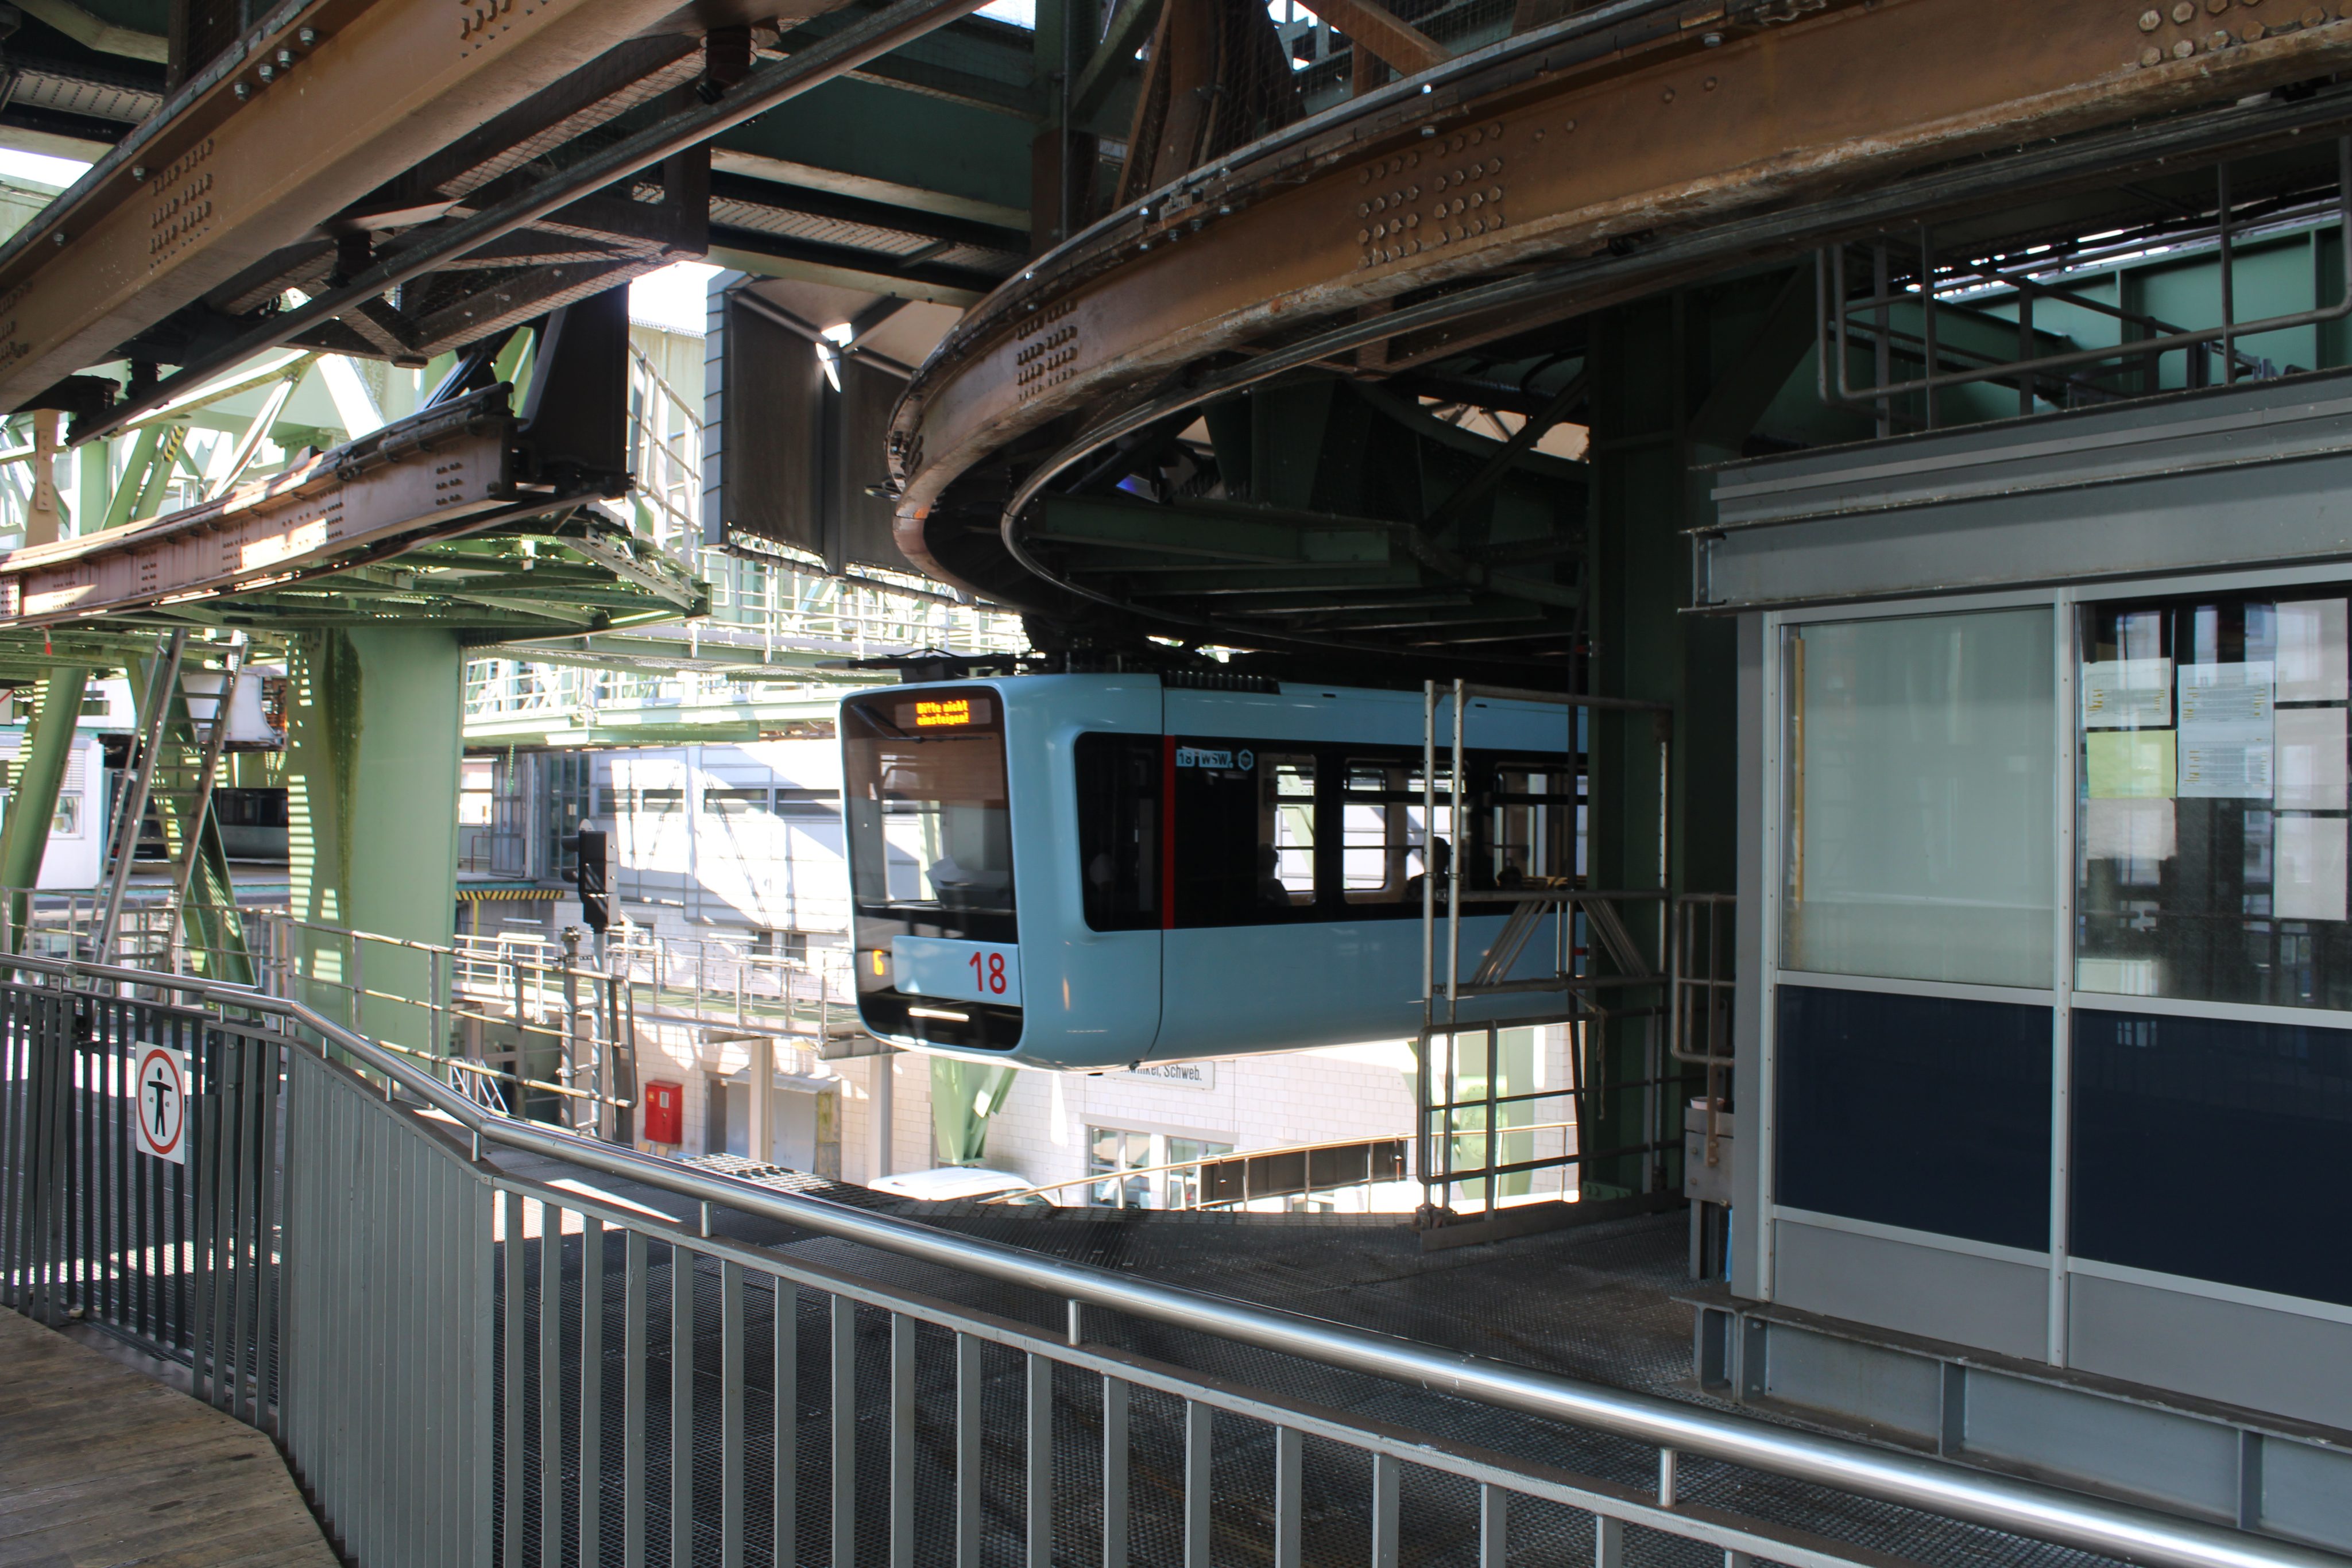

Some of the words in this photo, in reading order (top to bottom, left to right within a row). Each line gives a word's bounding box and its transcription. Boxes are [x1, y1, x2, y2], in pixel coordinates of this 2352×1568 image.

[916, 702, 942, 714] Bitte
[943, 700, 969, 712] nicht
[916, 711, 969, 726] einsteigen!
[1179, 752, 1192, 764] 18
[872, 949, 884, 975] 6
[969, 951, 1007, 994] 18
[1164, 1065, 1202, 1081] Schweb.
